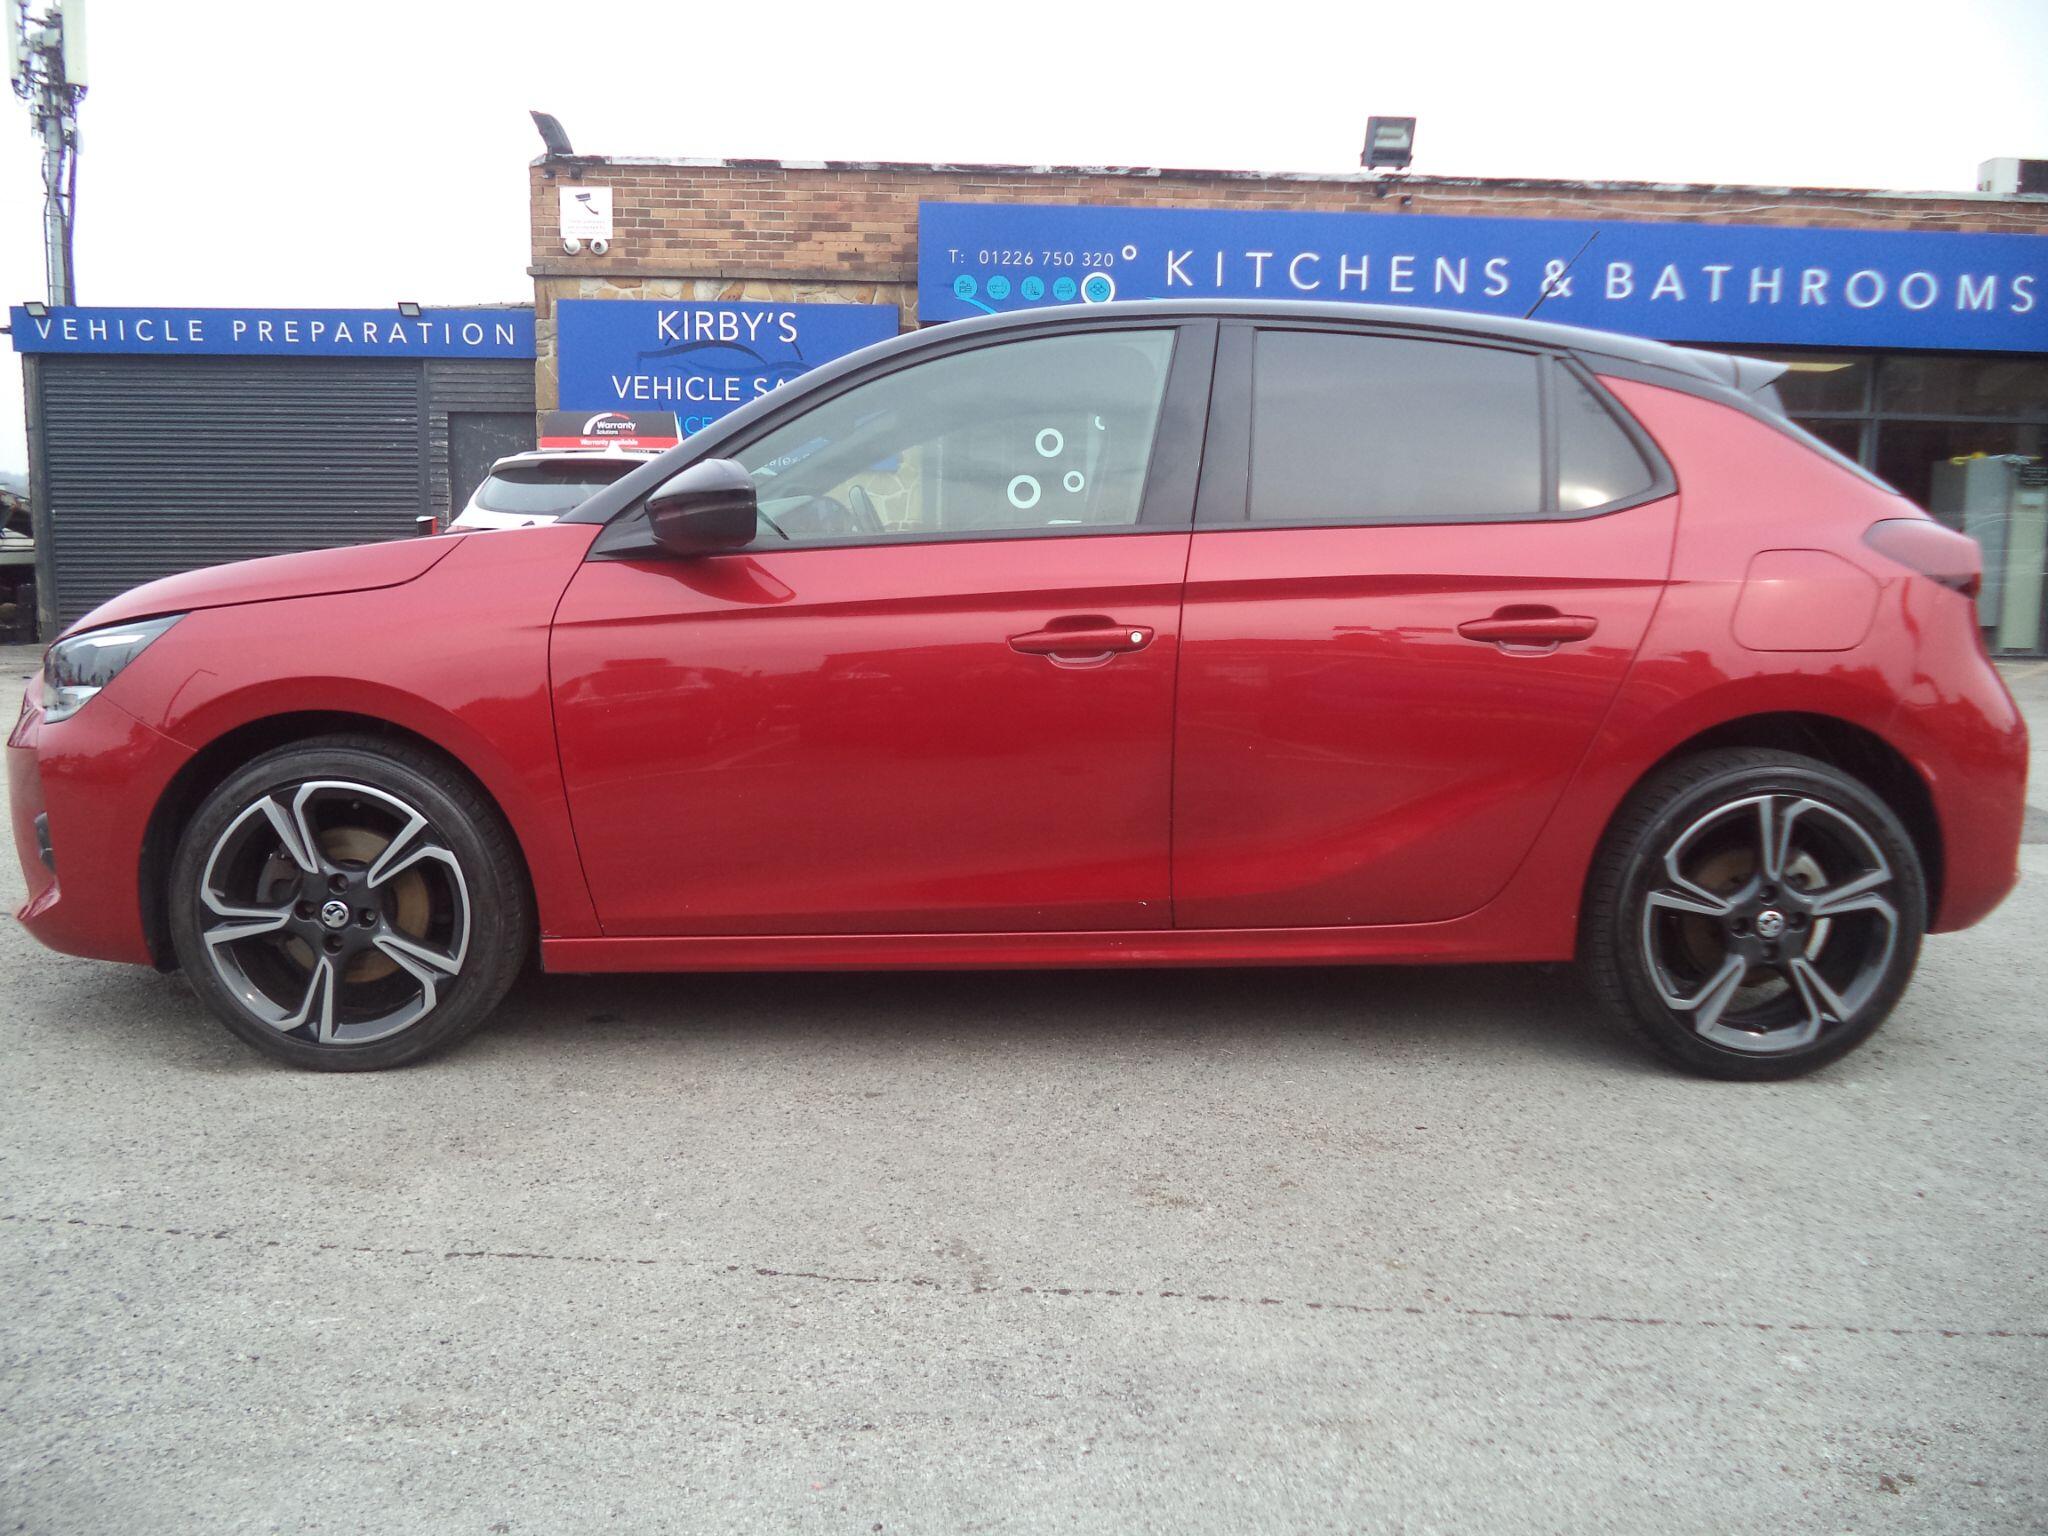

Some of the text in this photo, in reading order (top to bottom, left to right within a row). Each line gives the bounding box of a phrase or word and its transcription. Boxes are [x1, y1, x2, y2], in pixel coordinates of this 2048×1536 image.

[949, 249, 1114, 267] T: 01226 750 320
[1166, 250, 2036, 312] KITCHENS & BATHROOMS
[35, 318, 514, 345] VEHICLE PREPARATION
[658, 310, 798, 343] KIRBY'S
[611, 375, 741, 401] VEHICLE
[596, 421, 636, 431] Warranty
